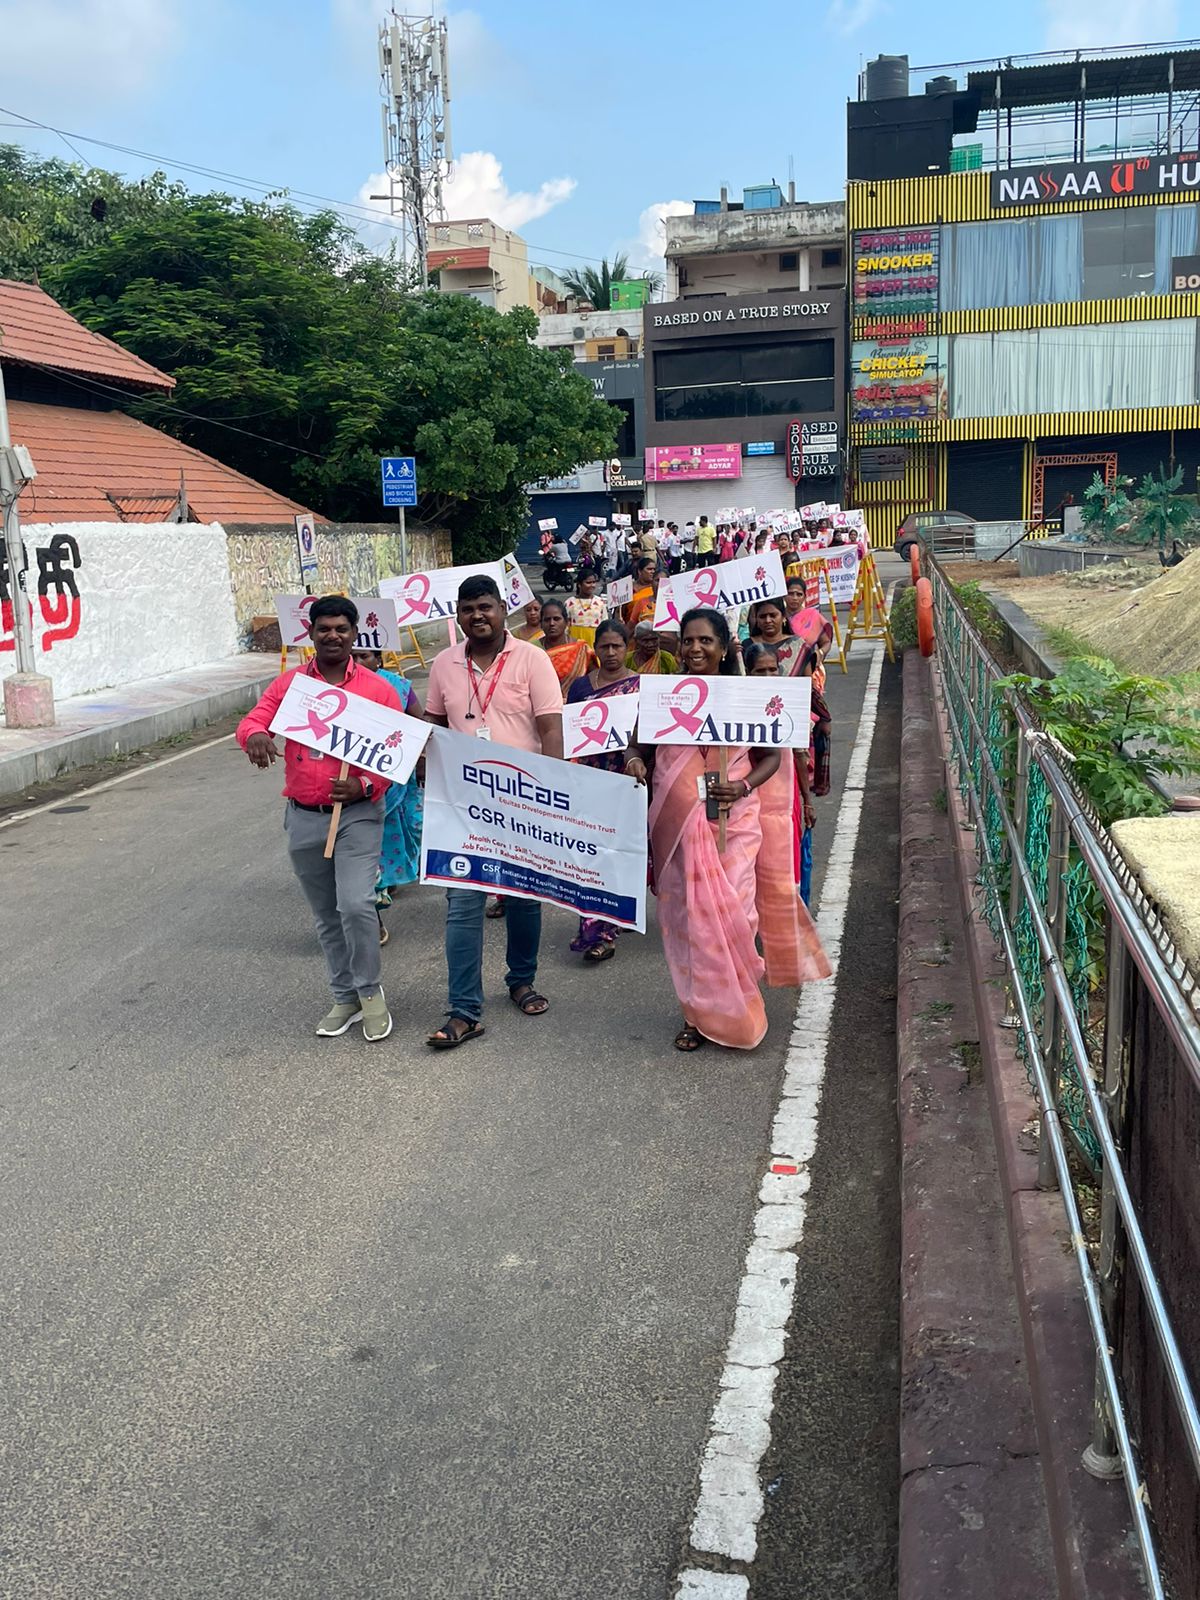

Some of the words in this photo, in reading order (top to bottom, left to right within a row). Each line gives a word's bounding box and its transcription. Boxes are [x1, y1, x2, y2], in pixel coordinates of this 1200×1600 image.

[857, 253, 934, 272] SNOOKER
[654, 313, 700, 327] BASED
[703, 310, 722, 323] ON
[726, 309, 737, 321] A
[739, 306, 779, 319] TRUE
[782, 303, 831, 317] STORY
[860, 355, 928, 372] CRICKET
[869, 368, 925, 380] SIMULATOR
[791, 421, 838, 434] BASED
[791, 434, 810, 444] ON
[791, 454, 829, 465] TRUE
[792, 464, 837, 477] STORY
[716, 580, 771, 610] Aunt
[695, 713, 784, 744] Aunt
[329, 723, 393, 773] Wife
[462, 763, 570, 811] equitas
[499, 796, 521, 809] Equitas
[522, 803, 564, 822] Development
[565, 815, 597, 831] Initiatives
[598, 824, 617, 834] Trust
[468, 804, 506, 829] CSR
[511, 817, 598, 856] Initiatives
[461, 842, 475, 850] Job
[476, 843, 493, 854] Fairs
[469, 833, 492, 846] Health
[492, 838, 507, 849] Care
[514, 845, 528, 854] Skill
[564, 861, 601, 877] Exhibitions
[482, 863, 501, 874] CSR
[501, 868, 528, 881] Initiative
[603, 898, 619, 908] Bank
